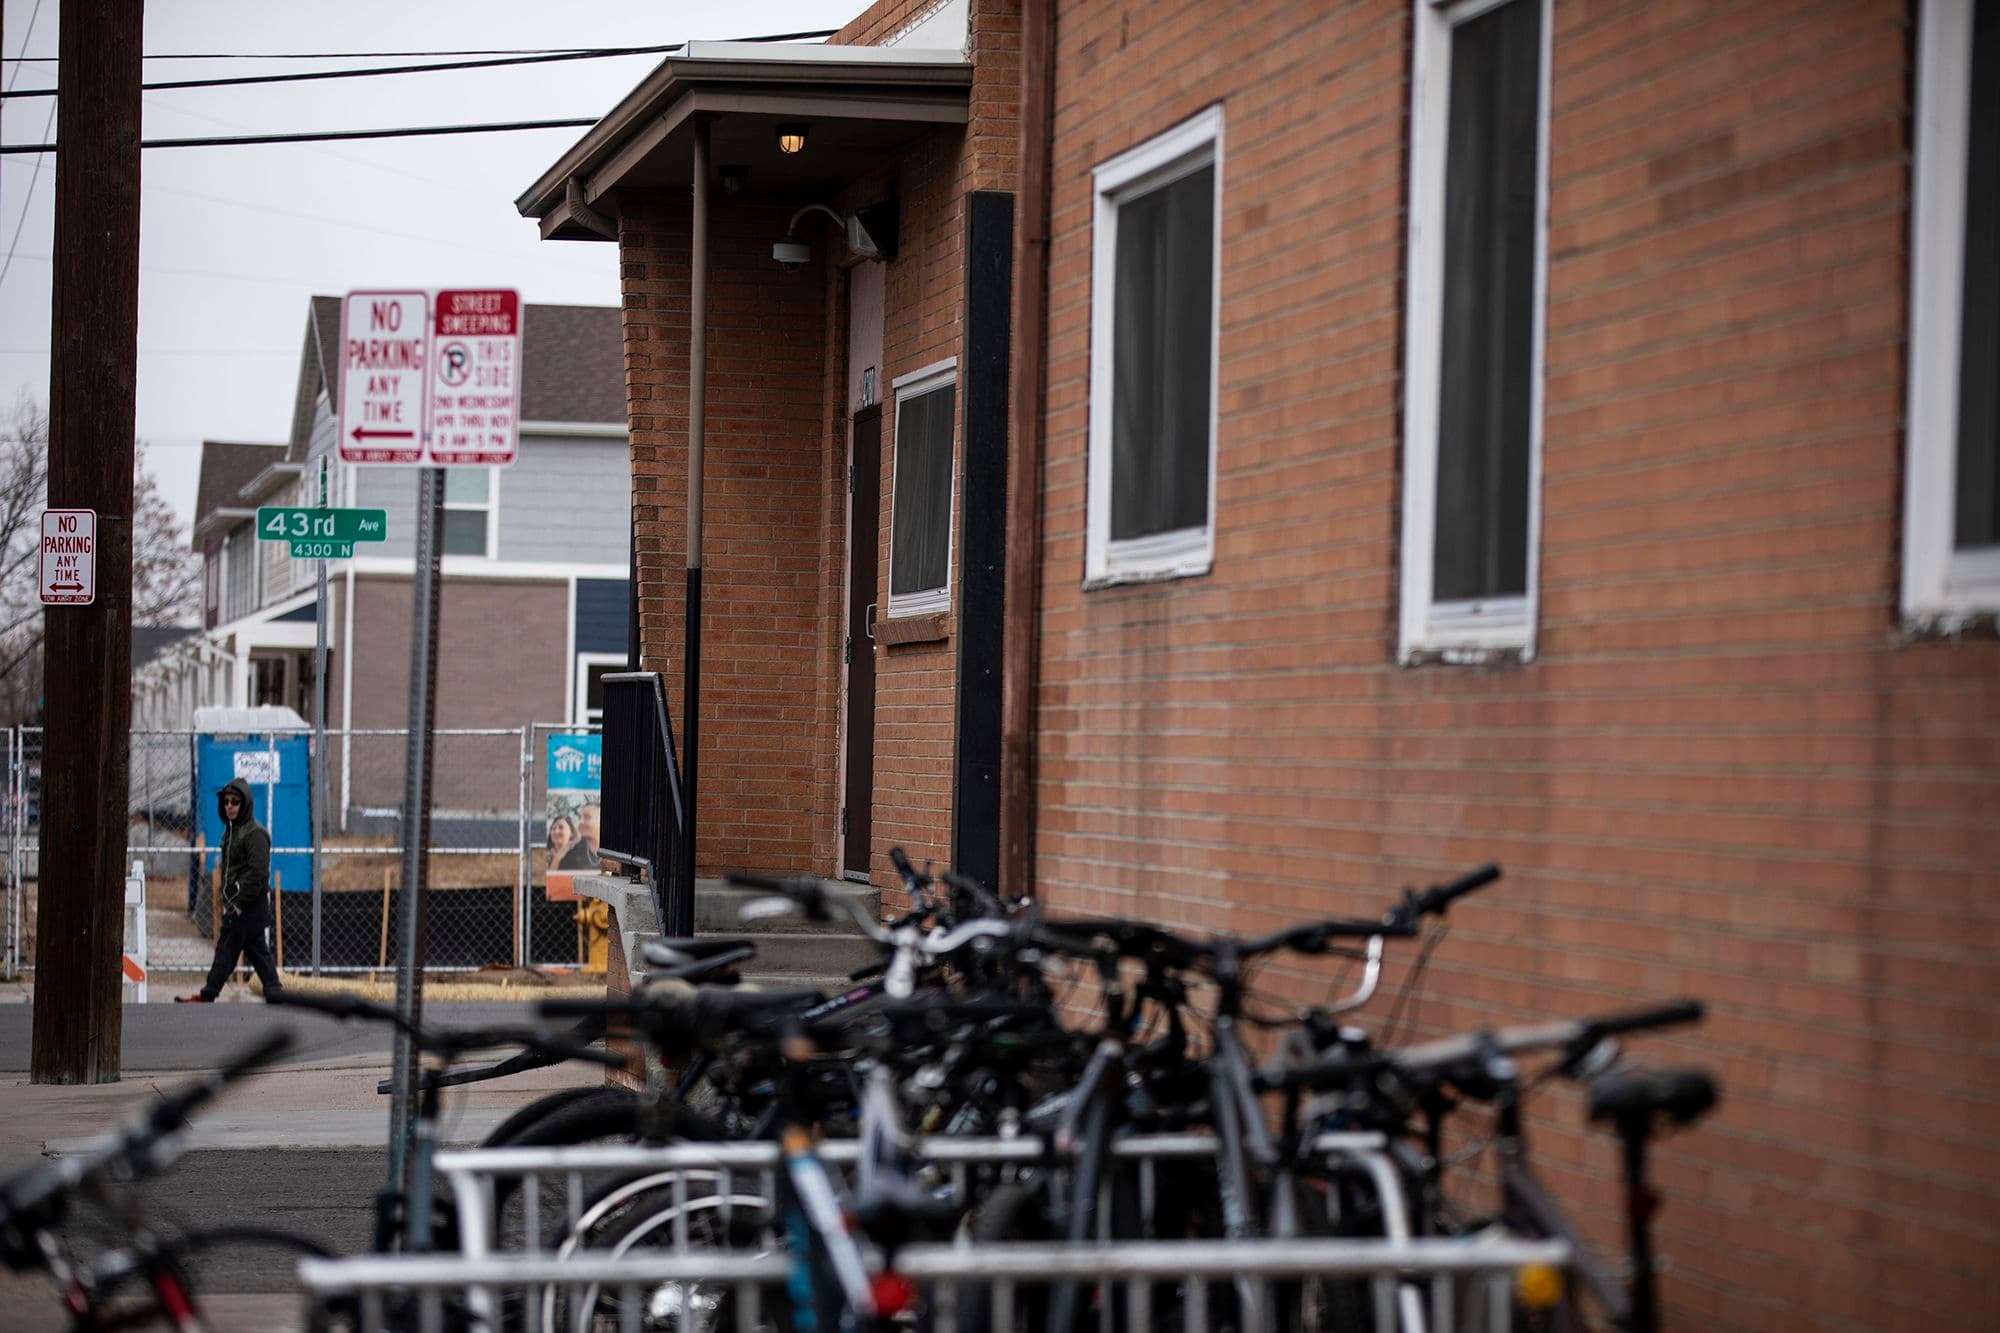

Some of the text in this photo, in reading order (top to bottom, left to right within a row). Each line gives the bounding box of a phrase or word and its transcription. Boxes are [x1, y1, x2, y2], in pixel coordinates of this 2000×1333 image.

[451, 294, 503, 313] STREET
[371, 301, 402, 332] NO
[441, 314, 511, 334] SWEEPING
[348, 339, 424, 370] PARKING
[366, 375, 400, 396] ANY
[363, 401, 403, 422] TIME
[58, 515, 77, 533] NO
[265, 512, 379, 536] 43rd Ave
[44, 536, 91, 553] PARKING
[294, 543, 351, 556] 4300 N
[56, 555, 78, 567] ANY
[54, 569, 80, 581] TIME
